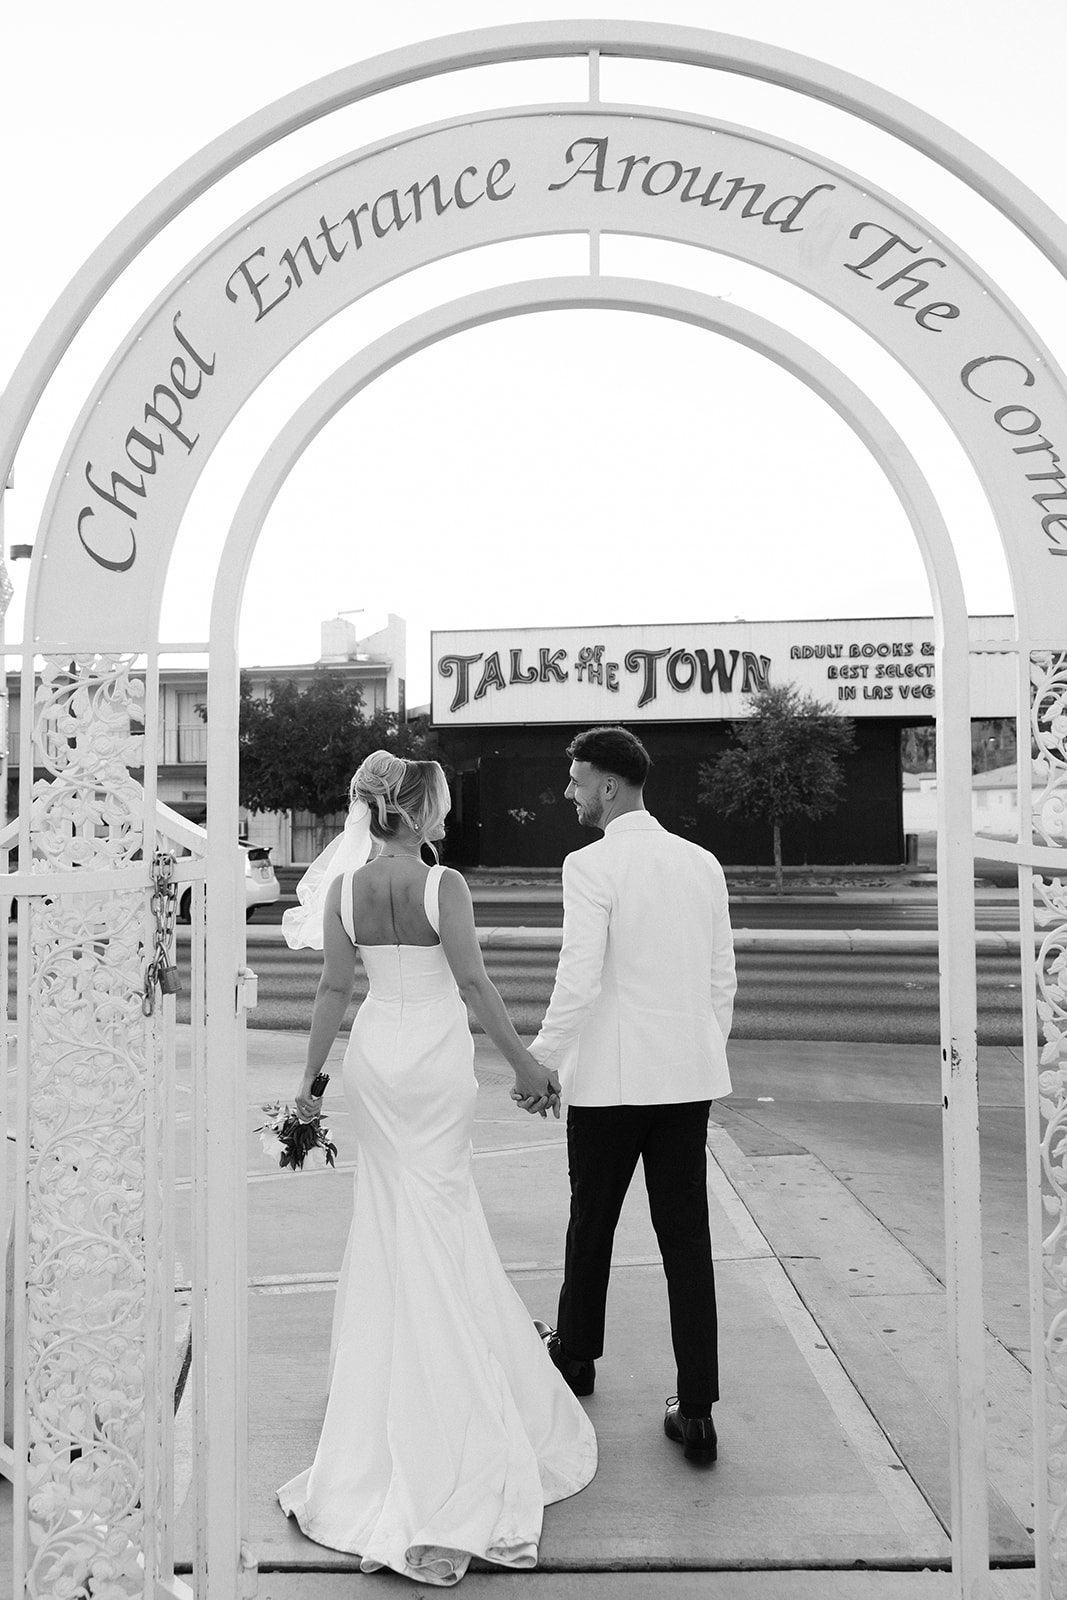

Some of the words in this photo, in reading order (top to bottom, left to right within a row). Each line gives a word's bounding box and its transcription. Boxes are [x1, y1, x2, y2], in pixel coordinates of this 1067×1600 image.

[77, 310, 216, 573] Chapel
[225, 157, 516, 323] Entrance
[547, 136, 836, 233] Around
[843, 221, 960, 333] The
[578, 645, 605, 663] OF
[790, 643, 844, 660] ADULT
[849, 642, 914, 658] BOOKS
[920, 641, 935, 657] &
[438, 648, 569, 712] TALK
[574, 662, 620, 693] THE
[624, 647, 771, 708] TOWN
[827, 664, 869, 680] BEST
[874, 662, 935, 679] SELECT
[838, 685, 857, 701] IN
[863, 685, 894, 700] LAS
